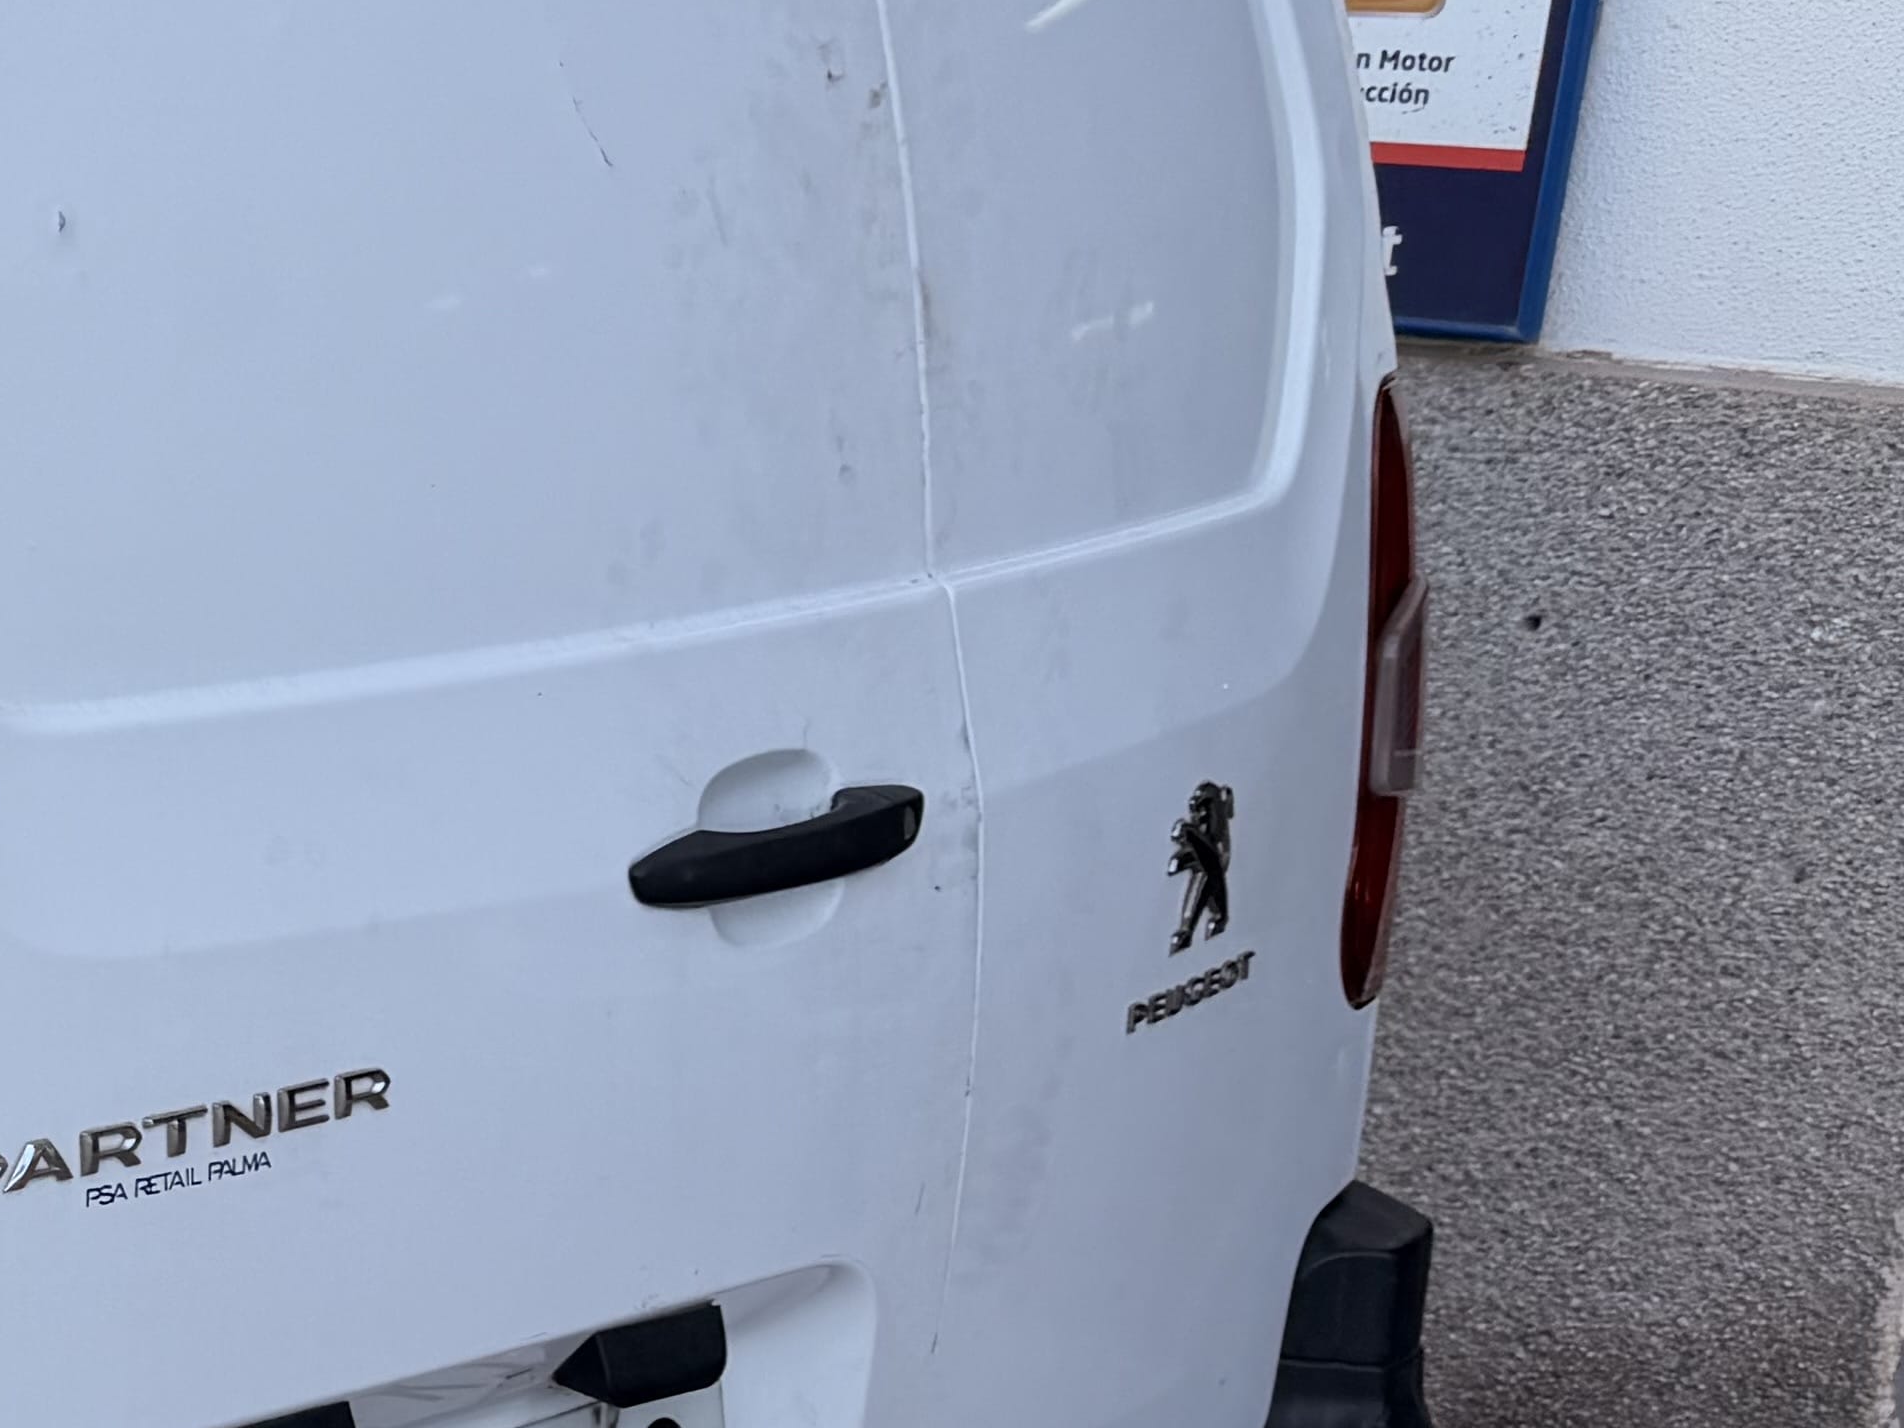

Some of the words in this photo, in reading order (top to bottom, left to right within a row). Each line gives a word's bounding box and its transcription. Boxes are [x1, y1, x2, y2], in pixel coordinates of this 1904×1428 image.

[1378, 49, 1457, 73] Motor
[1360, 82, 1430, 105] cción
[1125, 950, 1257, 1035] PEUGEOT
[85, 1182, 129, 1209] PSA
[134, 1167, 203, 1199] RETAIL
[207, 1151, 272, 1183] PALMA
